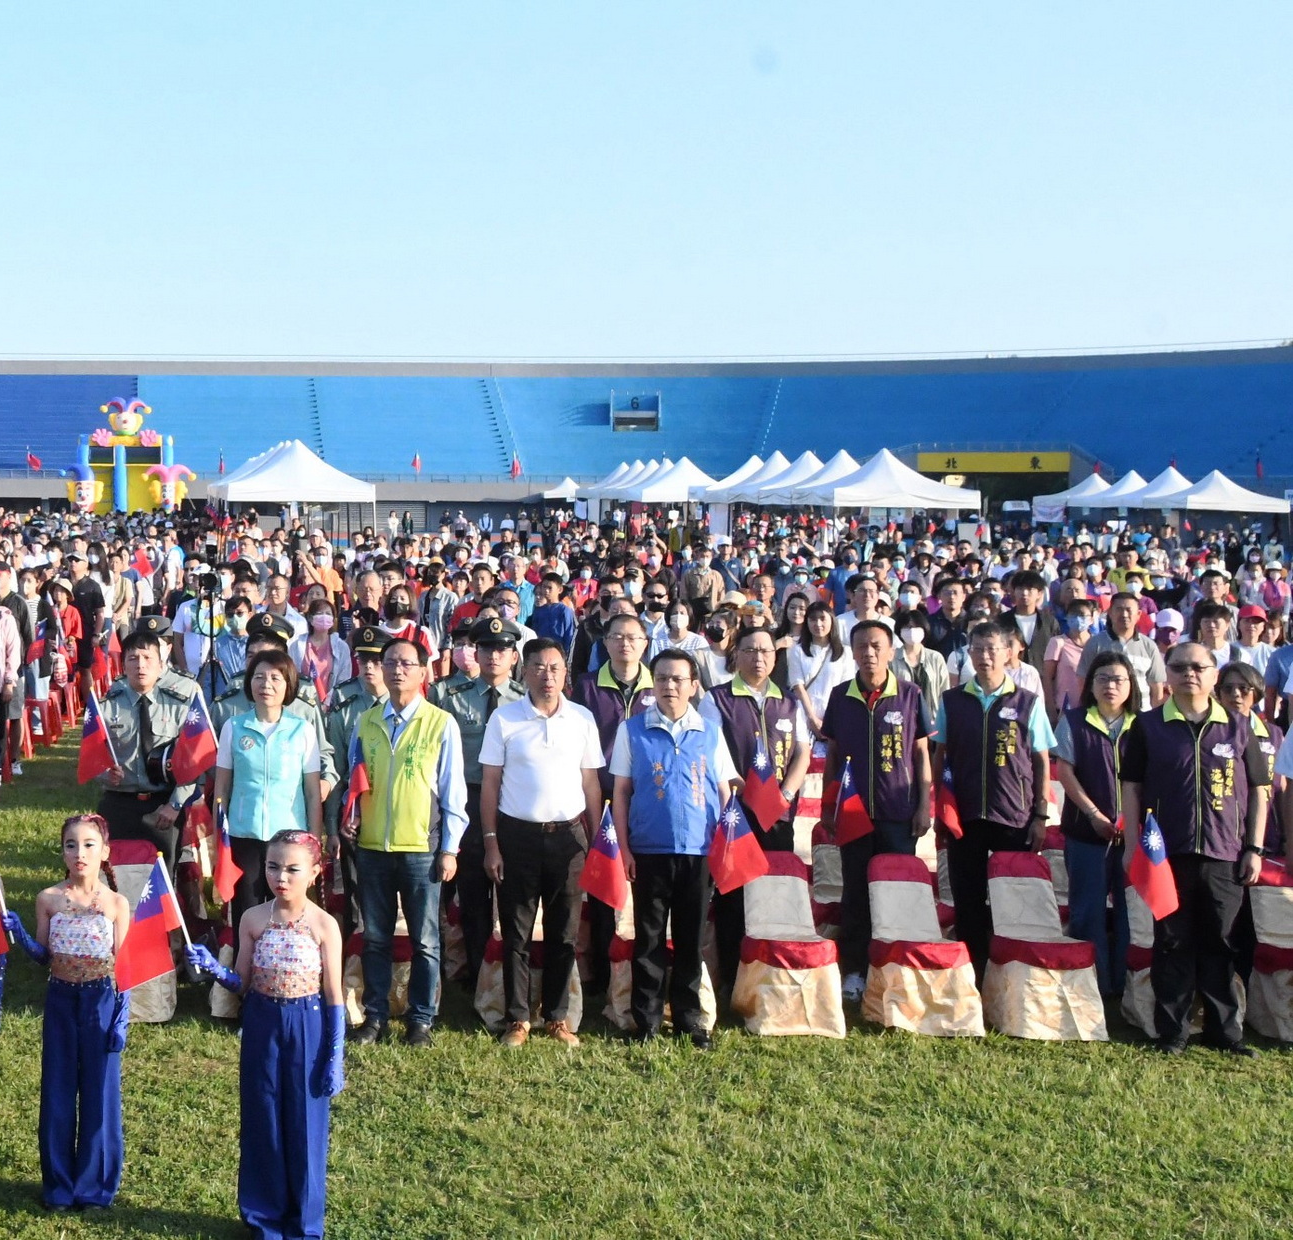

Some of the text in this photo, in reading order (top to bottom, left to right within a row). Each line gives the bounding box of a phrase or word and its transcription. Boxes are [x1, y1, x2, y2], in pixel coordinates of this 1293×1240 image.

[631, 397, 639, 409] 6
[945, 456, 1042, 470] 北 東
